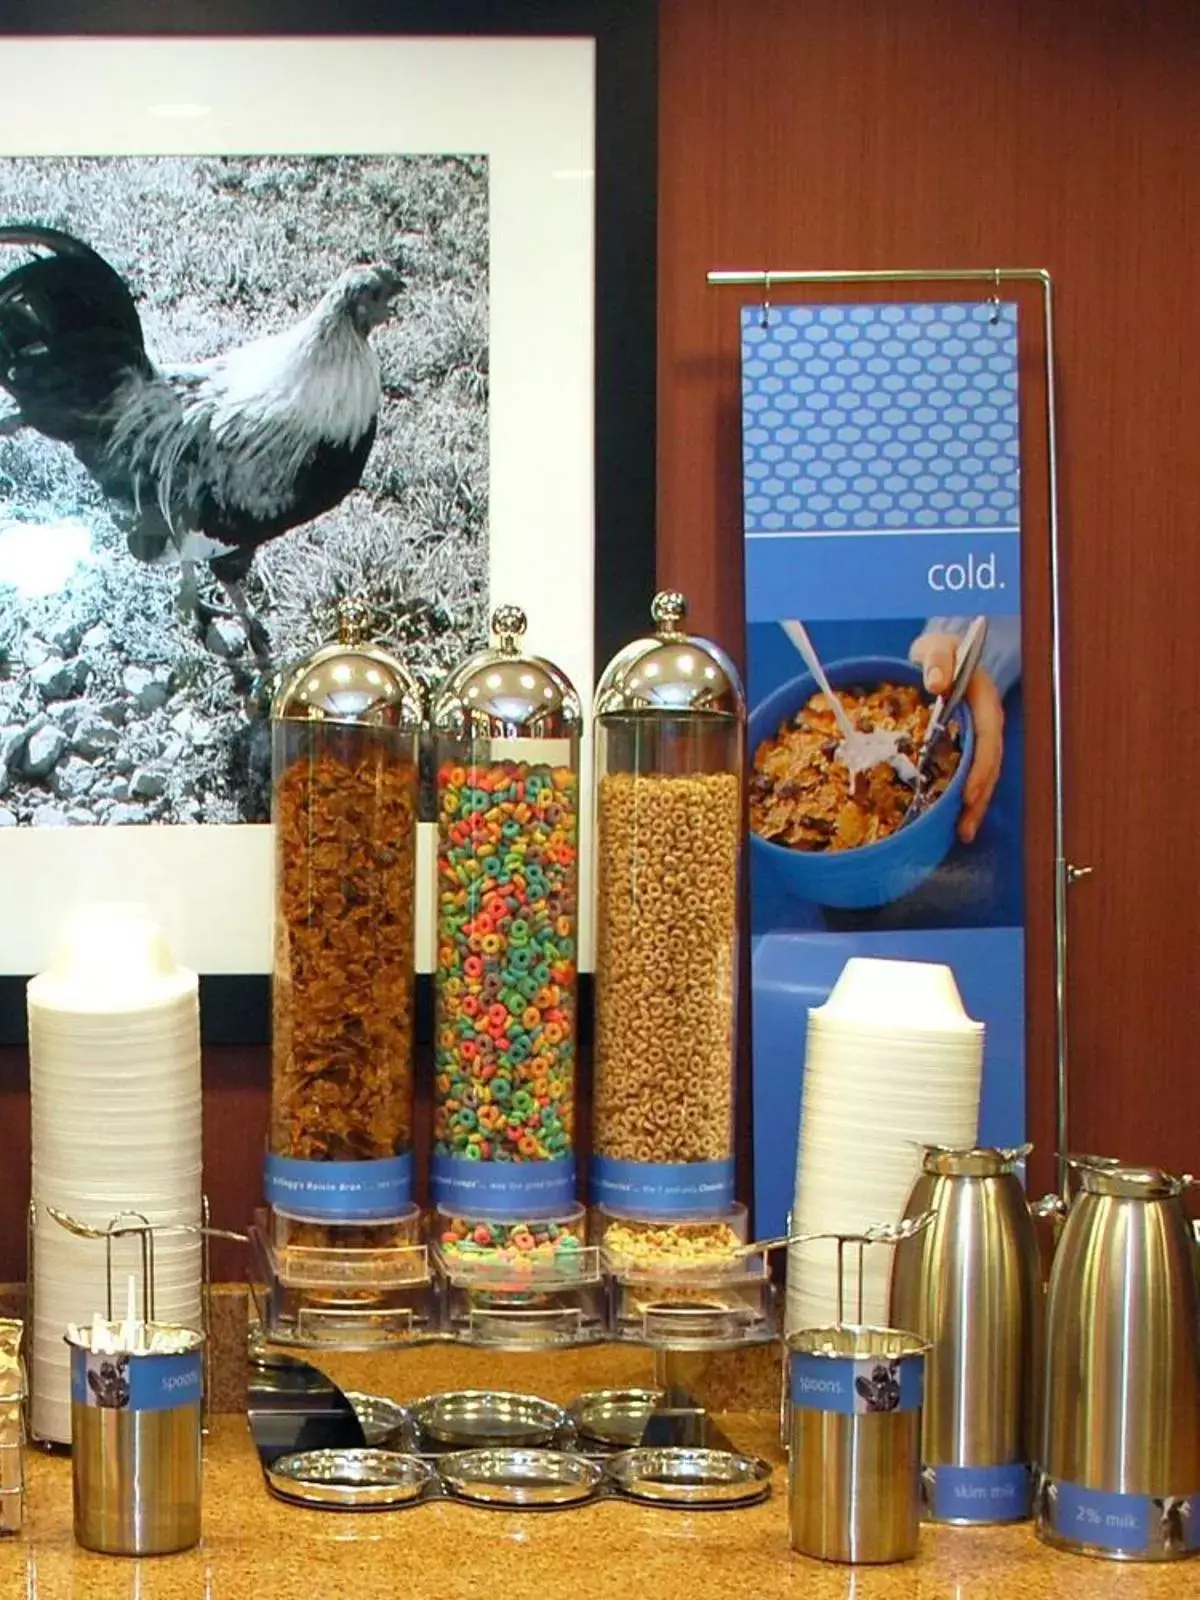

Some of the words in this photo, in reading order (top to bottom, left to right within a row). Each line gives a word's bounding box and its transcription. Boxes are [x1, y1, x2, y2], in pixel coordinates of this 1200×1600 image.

[927, 552, 1006, 591] cold.
[953, 1482, 988, 1499] skim
[1075, 1504, 1103, 1525] 2%
